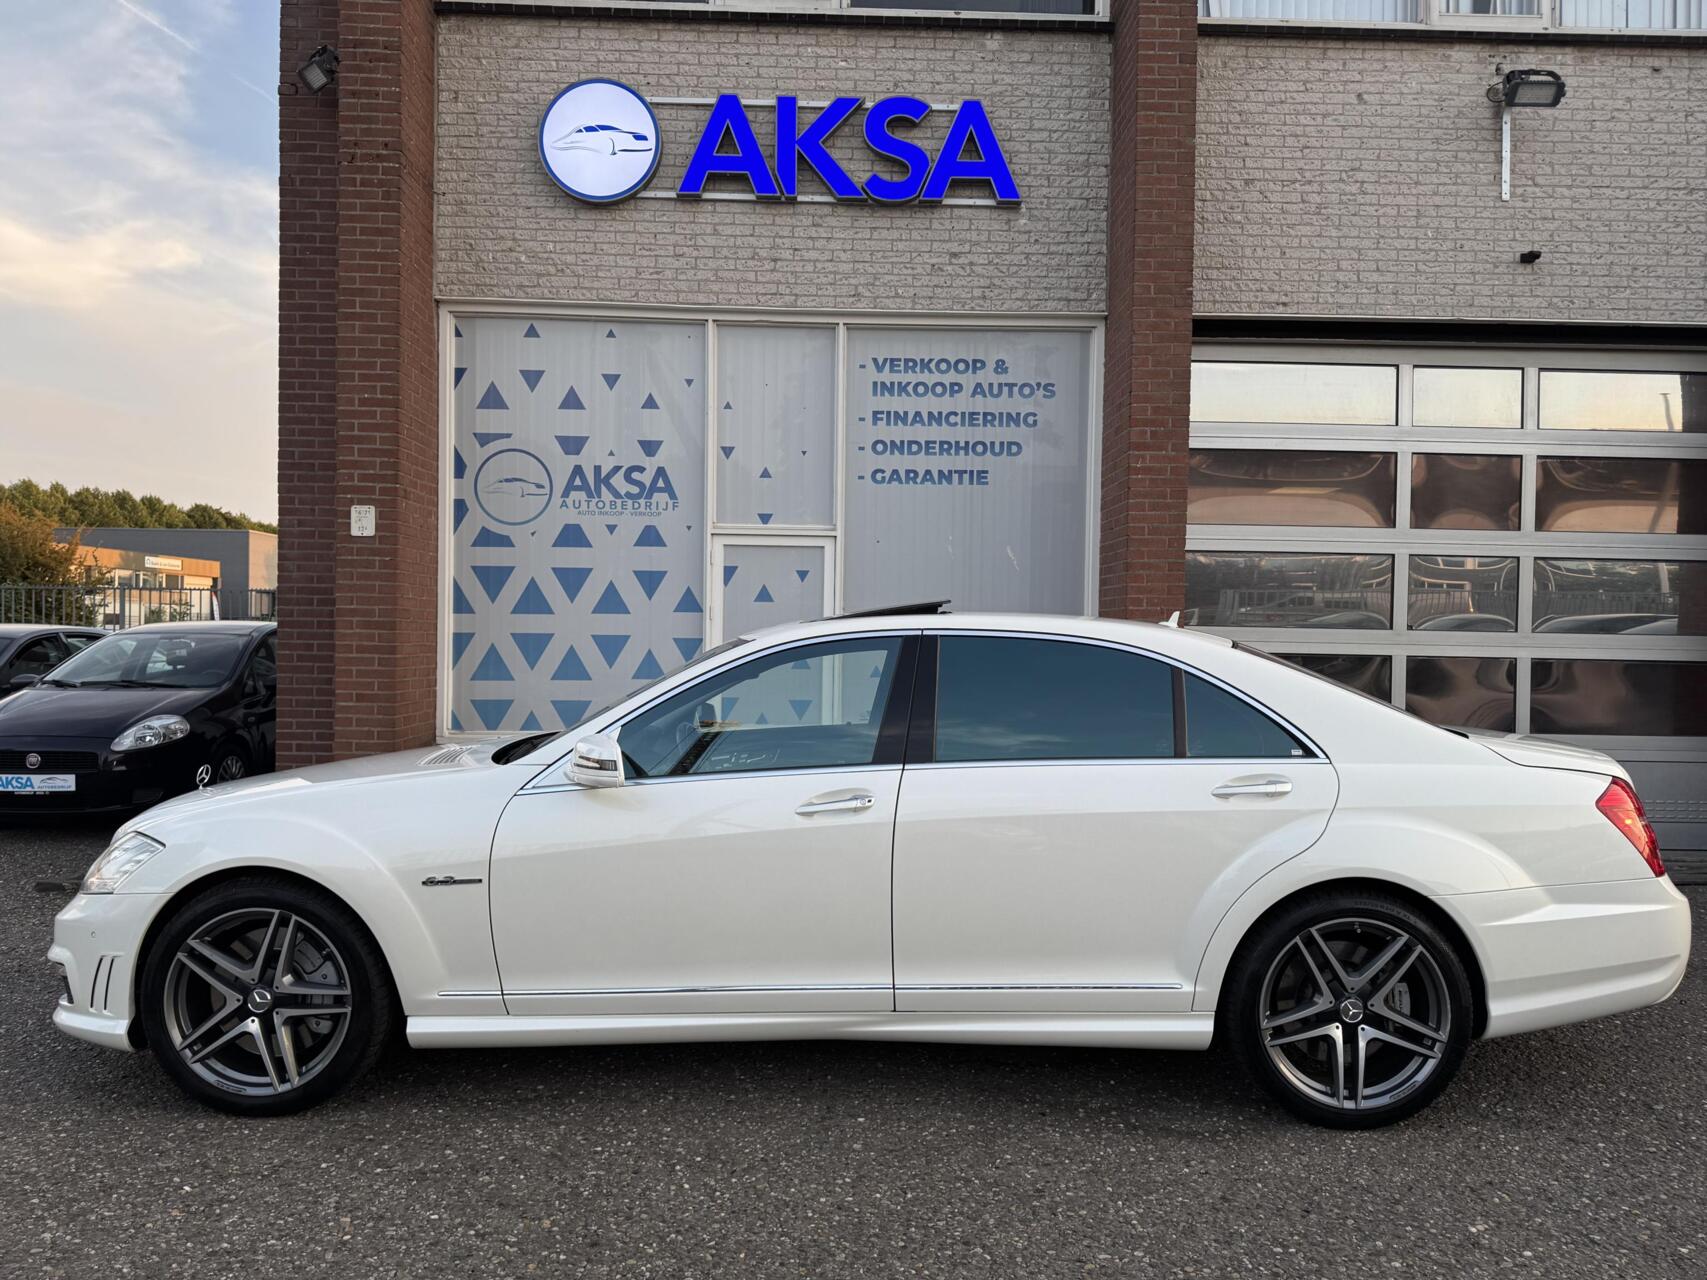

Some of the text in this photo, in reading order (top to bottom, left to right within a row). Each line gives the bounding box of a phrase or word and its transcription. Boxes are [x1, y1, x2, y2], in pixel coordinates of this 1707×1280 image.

[677, 94, 1022, 204] AKSA
[871, 357, 987, 375] VERKOOP
[993, 359, 1009, 376] &
[871, 381, 1057, 399] INKOOP AUTO'S
[871, 410, 1039, 428] FINANCIERING
[871, 439, 1023, 457] ONDERHOUD
[560, 464, 679, 501] AKSA
[870, 468, 989, 485] GARANTIE
[560, 499, 680, 512] AUTOBEDRIJF
